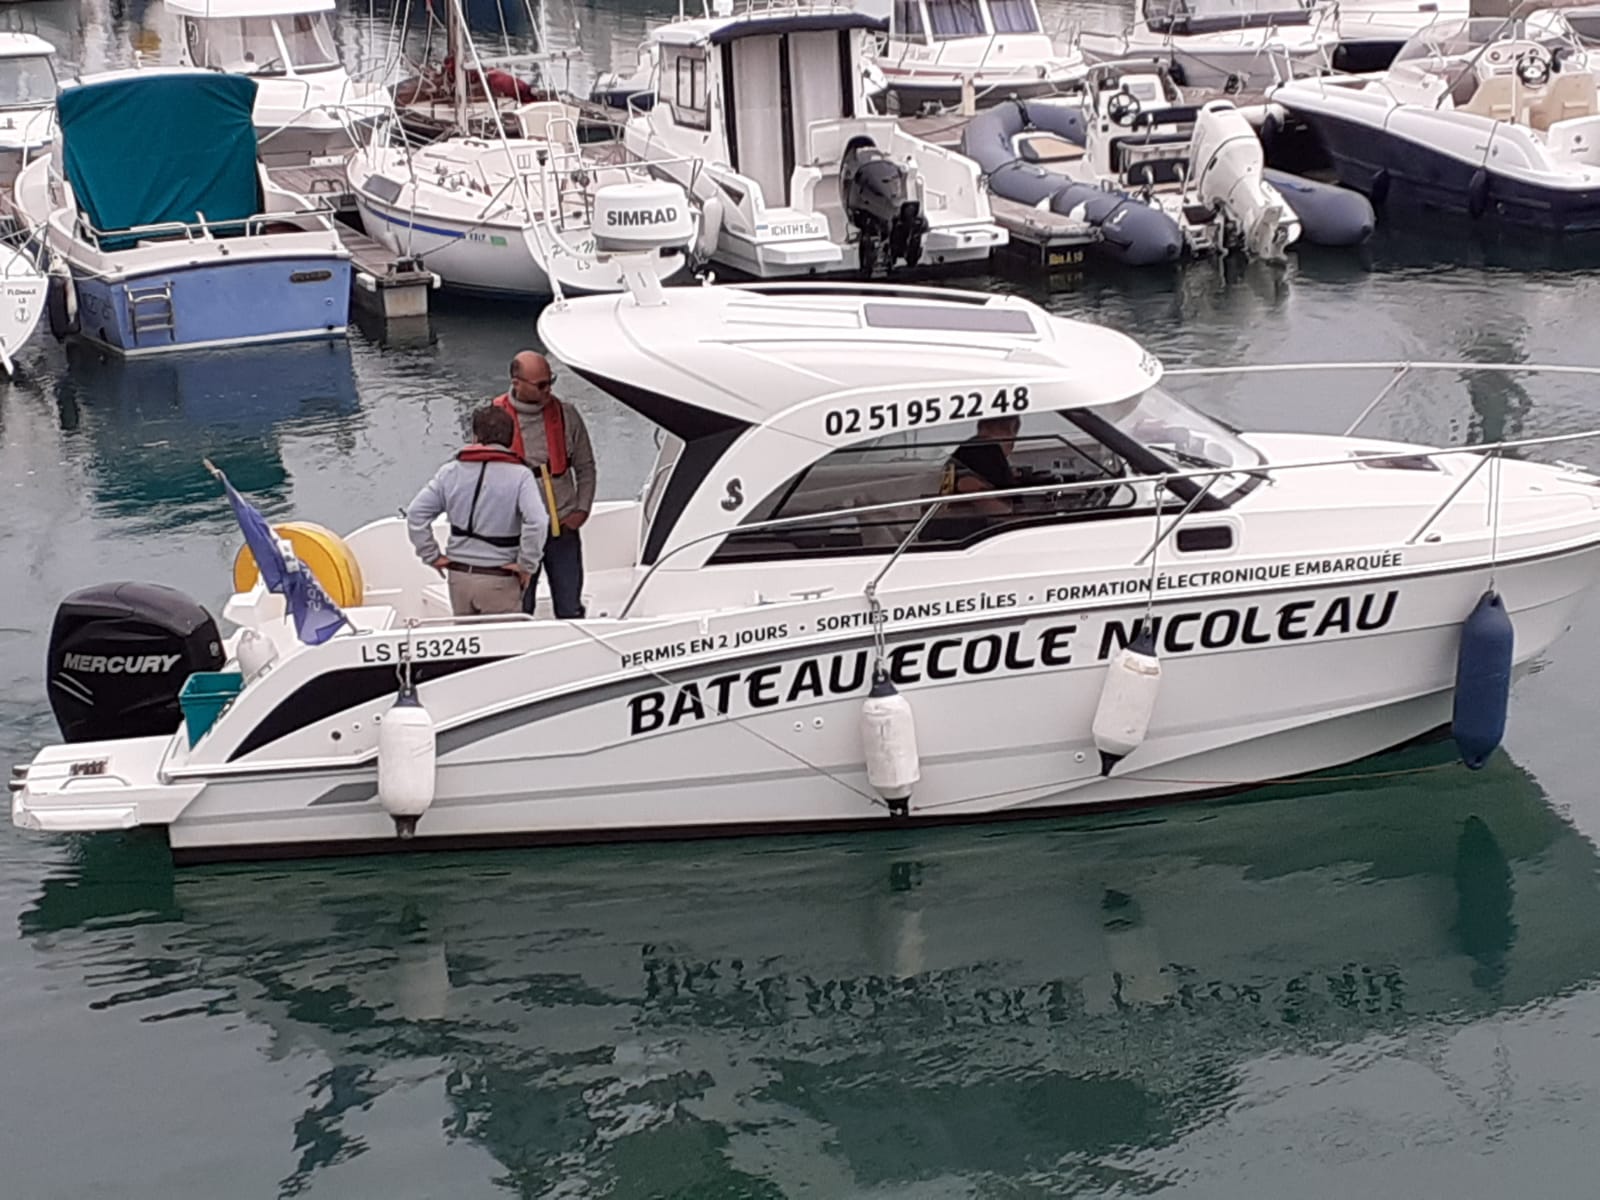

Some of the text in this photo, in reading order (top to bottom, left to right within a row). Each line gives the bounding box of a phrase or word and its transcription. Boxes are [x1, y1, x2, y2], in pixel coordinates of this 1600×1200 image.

[607, 207, 677, 226] SIMRAD
[825, 386, 1029, 436] 02 51 95 22 48
[1046, 550, 1402, 602] FORMATION ÉLECTRONIQUE EMBARQUÉE
[816, 592, 1017, 632] SORTIES DANS LES ÎLES
[63, 652, 182, 673] MERCURY
[361, 643, 391, 663] LS
[416, 637, 481, 658] 53245
[621, 624, 788, 668] PERMIS EN 2 JOURS
[626, 590, 1399, 736] BATEAU ECOLE NICOLEAU
